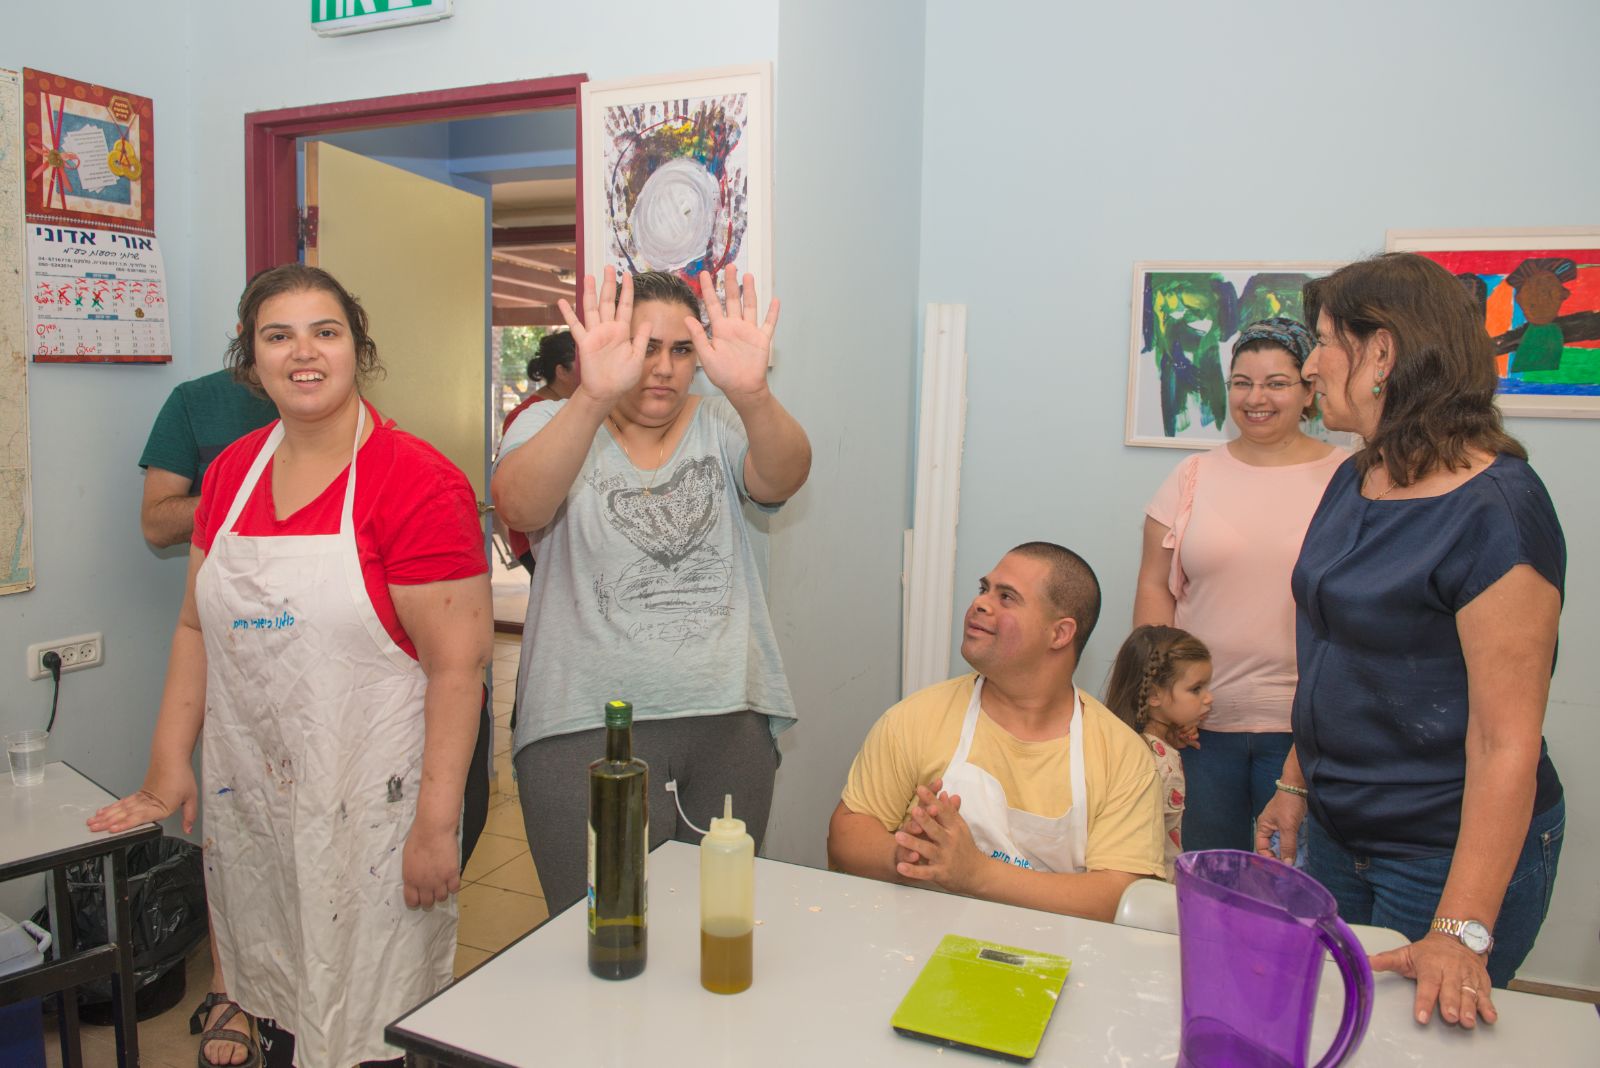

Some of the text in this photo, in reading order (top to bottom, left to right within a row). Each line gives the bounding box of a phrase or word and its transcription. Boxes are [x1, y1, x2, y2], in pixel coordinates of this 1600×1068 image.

[36, 227, 153, 251] אורי אדוני
[991, 850, 1011, 864] חיים
